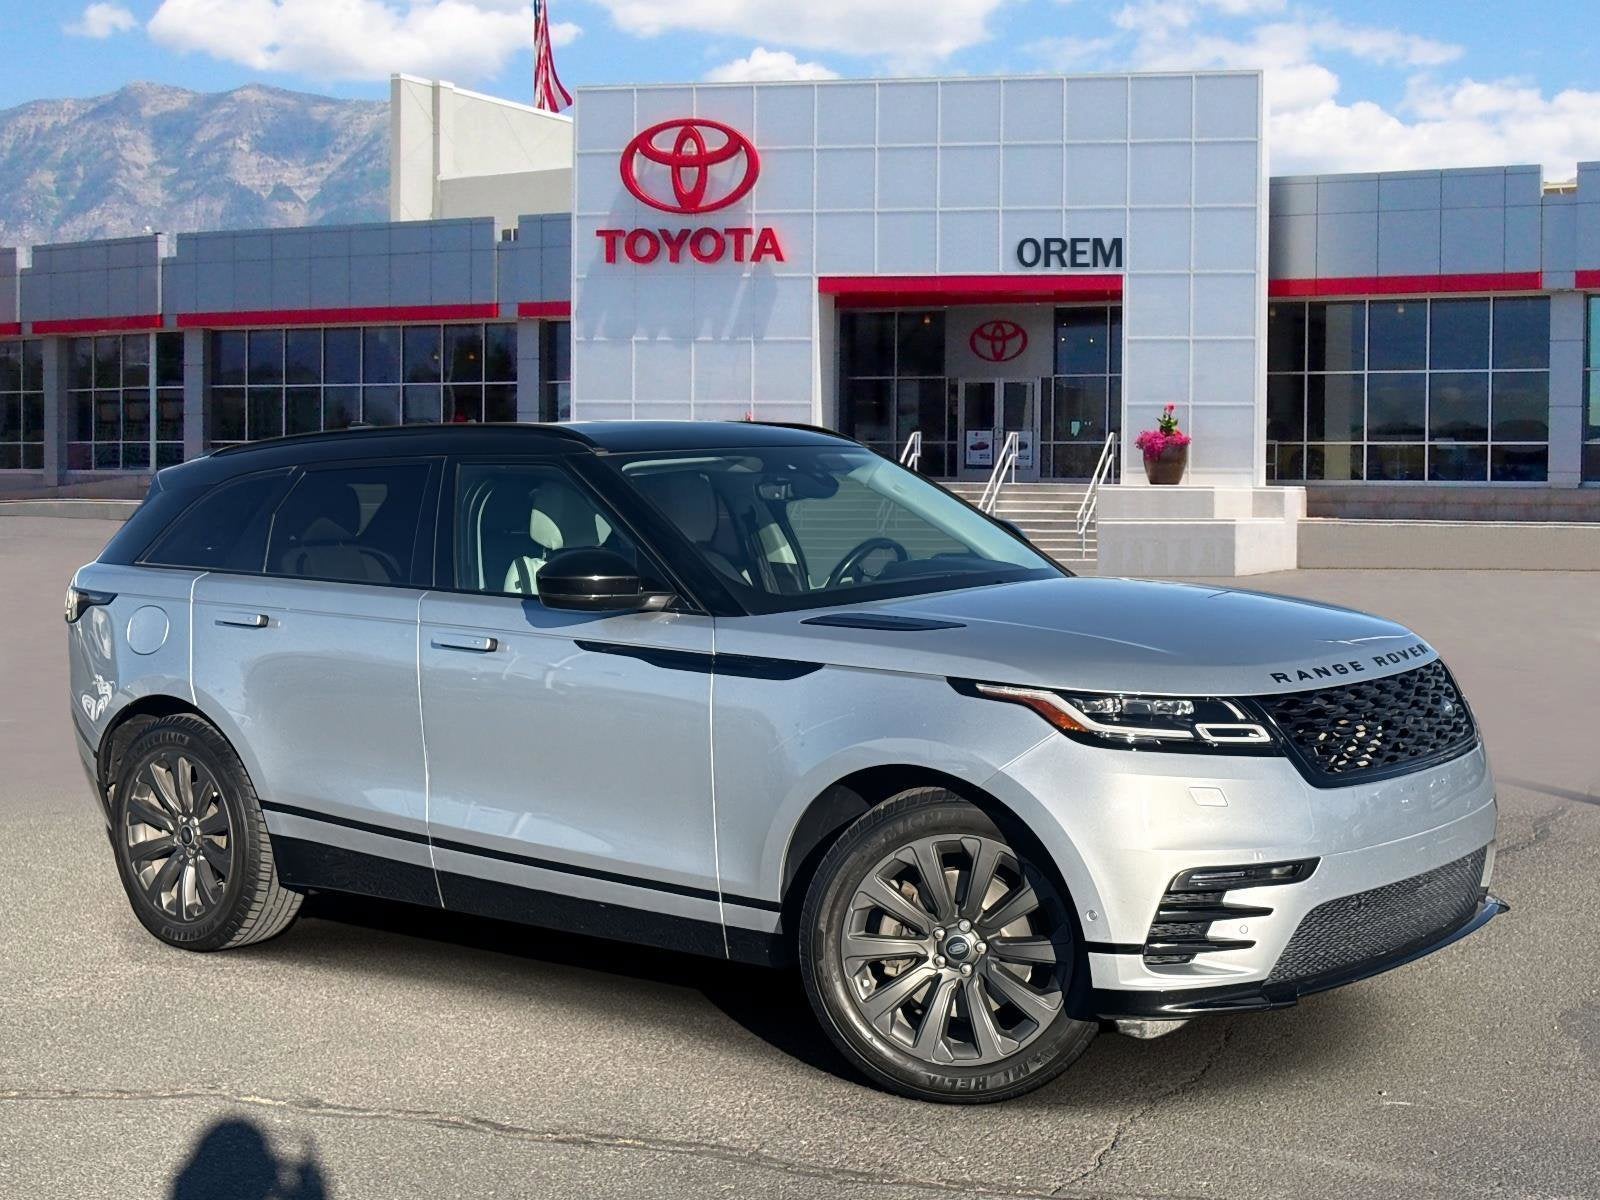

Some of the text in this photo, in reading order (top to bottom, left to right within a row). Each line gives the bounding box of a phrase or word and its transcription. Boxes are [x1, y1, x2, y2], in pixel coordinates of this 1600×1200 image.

[596, 227, 784, 264] TOYOTA
[1016, 237, 1122, 267] OREM
[1270, 643, 1429, 684] RANGE ROVER
